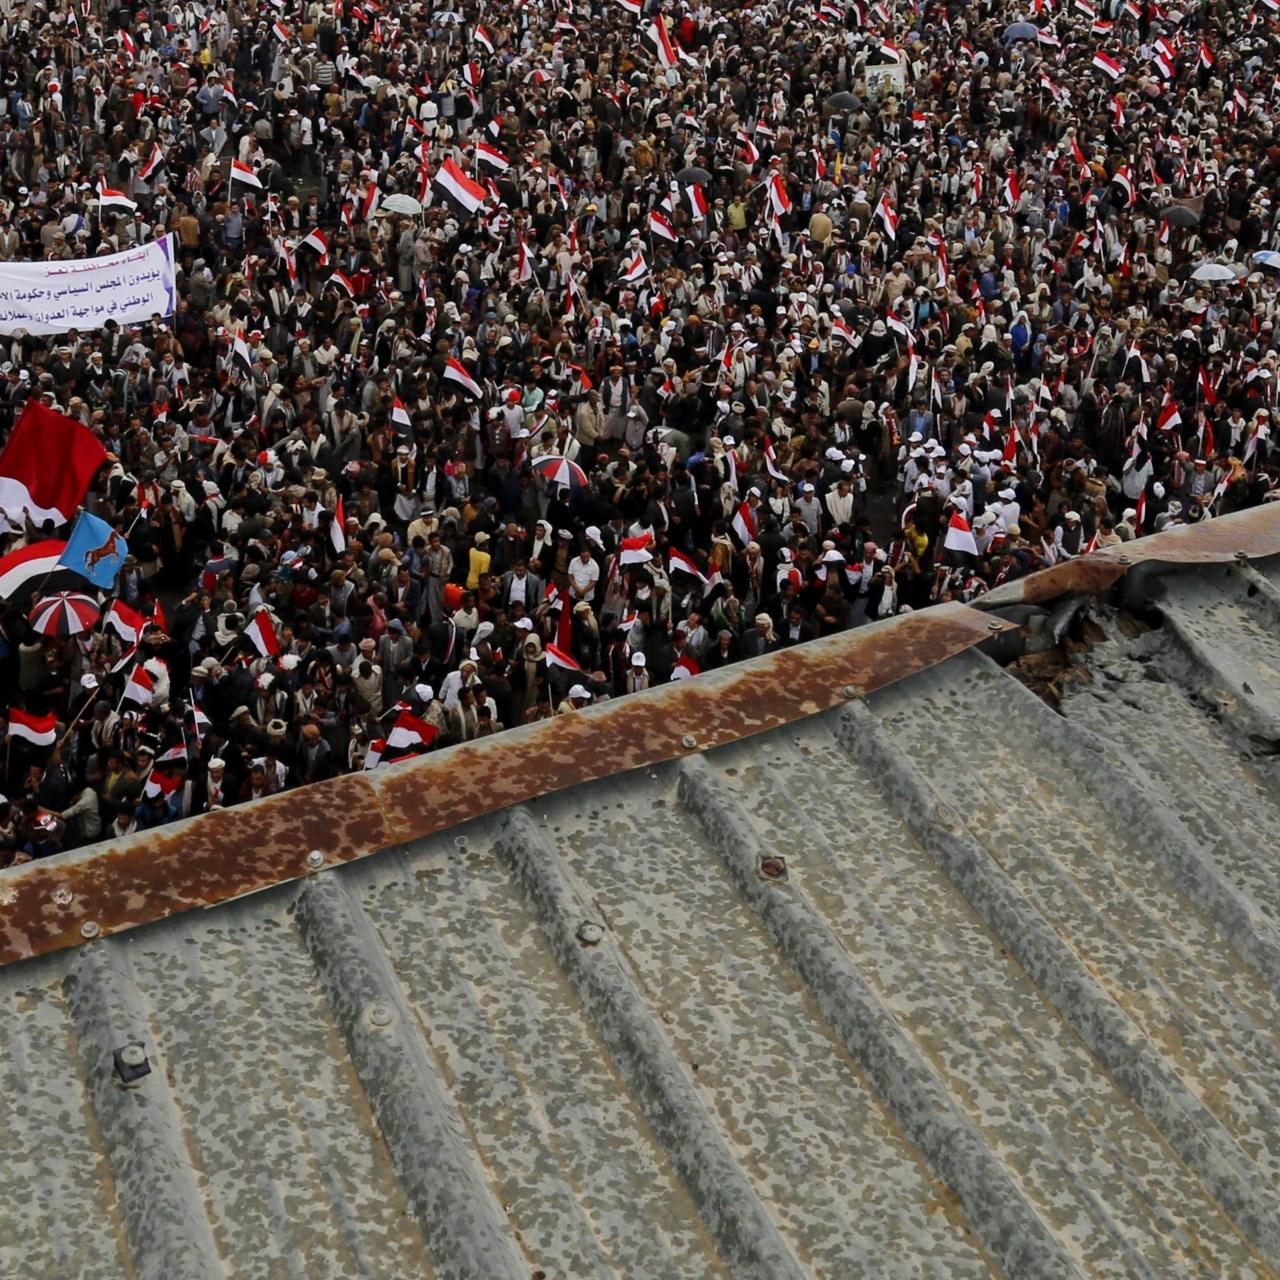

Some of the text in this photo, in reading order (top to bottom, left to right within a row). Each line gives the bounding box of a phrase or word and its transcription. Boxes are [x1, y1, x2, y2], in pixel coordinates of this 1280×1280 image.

[45, 265, 68, 278] تعز
[129, 268, 161, 286] يؤيدون
[54, 282, 93, 301] السياسي
[95, 275, 126, 293] المجلس
[13, 287, 51, 302] وحكومة
[120, 292, 154, 313] الوطني
[70, 304, 104, 318] مواجهة
[107, 298, 118, 315] في
[34, 308, 69, 324] العدوان
